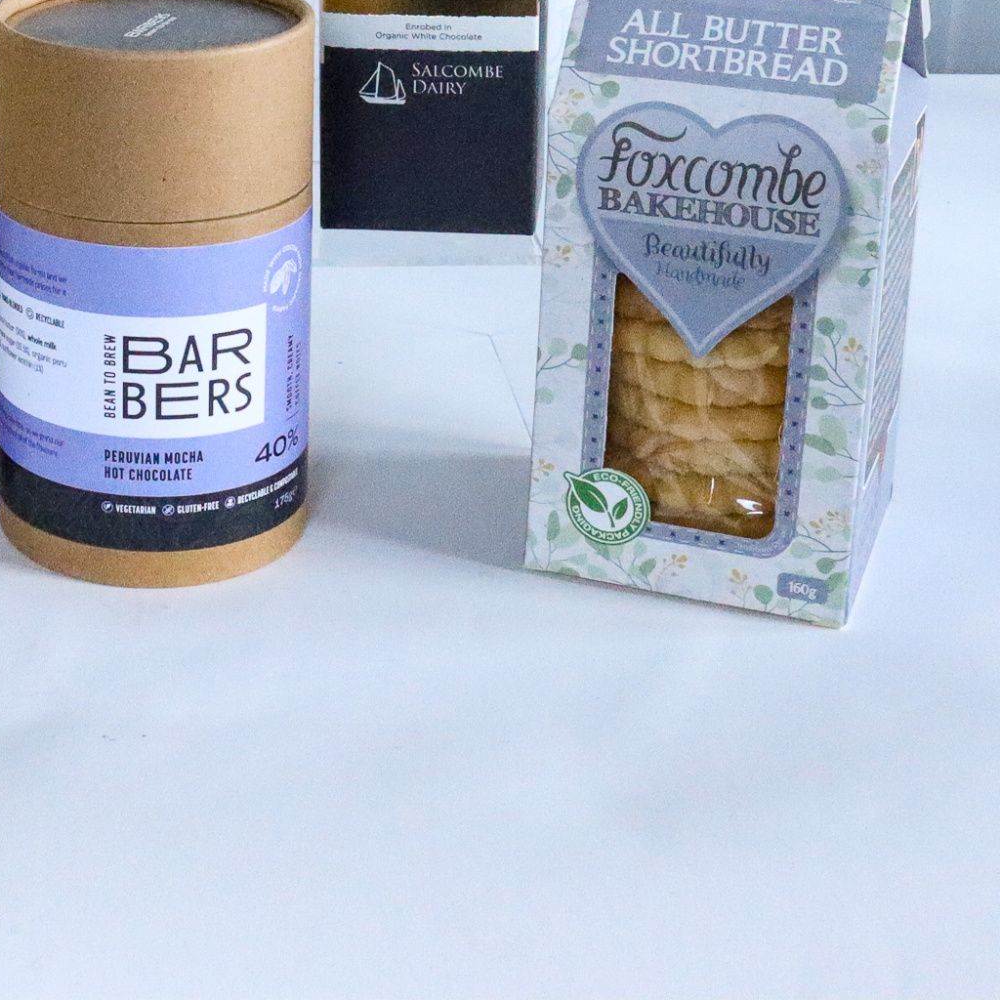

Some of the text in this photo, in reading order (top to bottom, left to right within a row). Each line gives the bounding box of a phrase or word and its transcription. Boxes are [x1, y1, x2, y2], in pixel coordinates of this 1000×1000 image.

[375, 32, 408, 41] Organic
[439, 33, 483, 41] Chocolate
[405, 23, 442, 31] Enrobed
[620, 8, 843, 55] ALL BUTTER
[412, 62, 504, 79] SALCOMBE
[606, 36, 848, 87] SHORTBREAD
[413, 79, 467, 95] DAIRY
[597, 187, 821, 238] BAKEHOUSE
[642, 233, 772, 276] Beautifully
[122, 328, 253, 375] BAR
[104, 334, 116, 418] BEAN TO BREW
[122, 372, 252, 420] BERS
[104, 449, 204, 465] PERUVIAN MOCHA
[255, 424, 299, 463] 40%
[104, 466, 193, 482] HOT CHOCOLATE
[115, 503, 156, 515] VEGETARIAN
[176, 500, 220, 514] GLUTEN-FREE
[236, 485, 270, 505] RECYCLABLE
[571, 472, 643, 541] ECO-FRIENDLY PACKAGING
[788, 581, 818, 600] 160g
